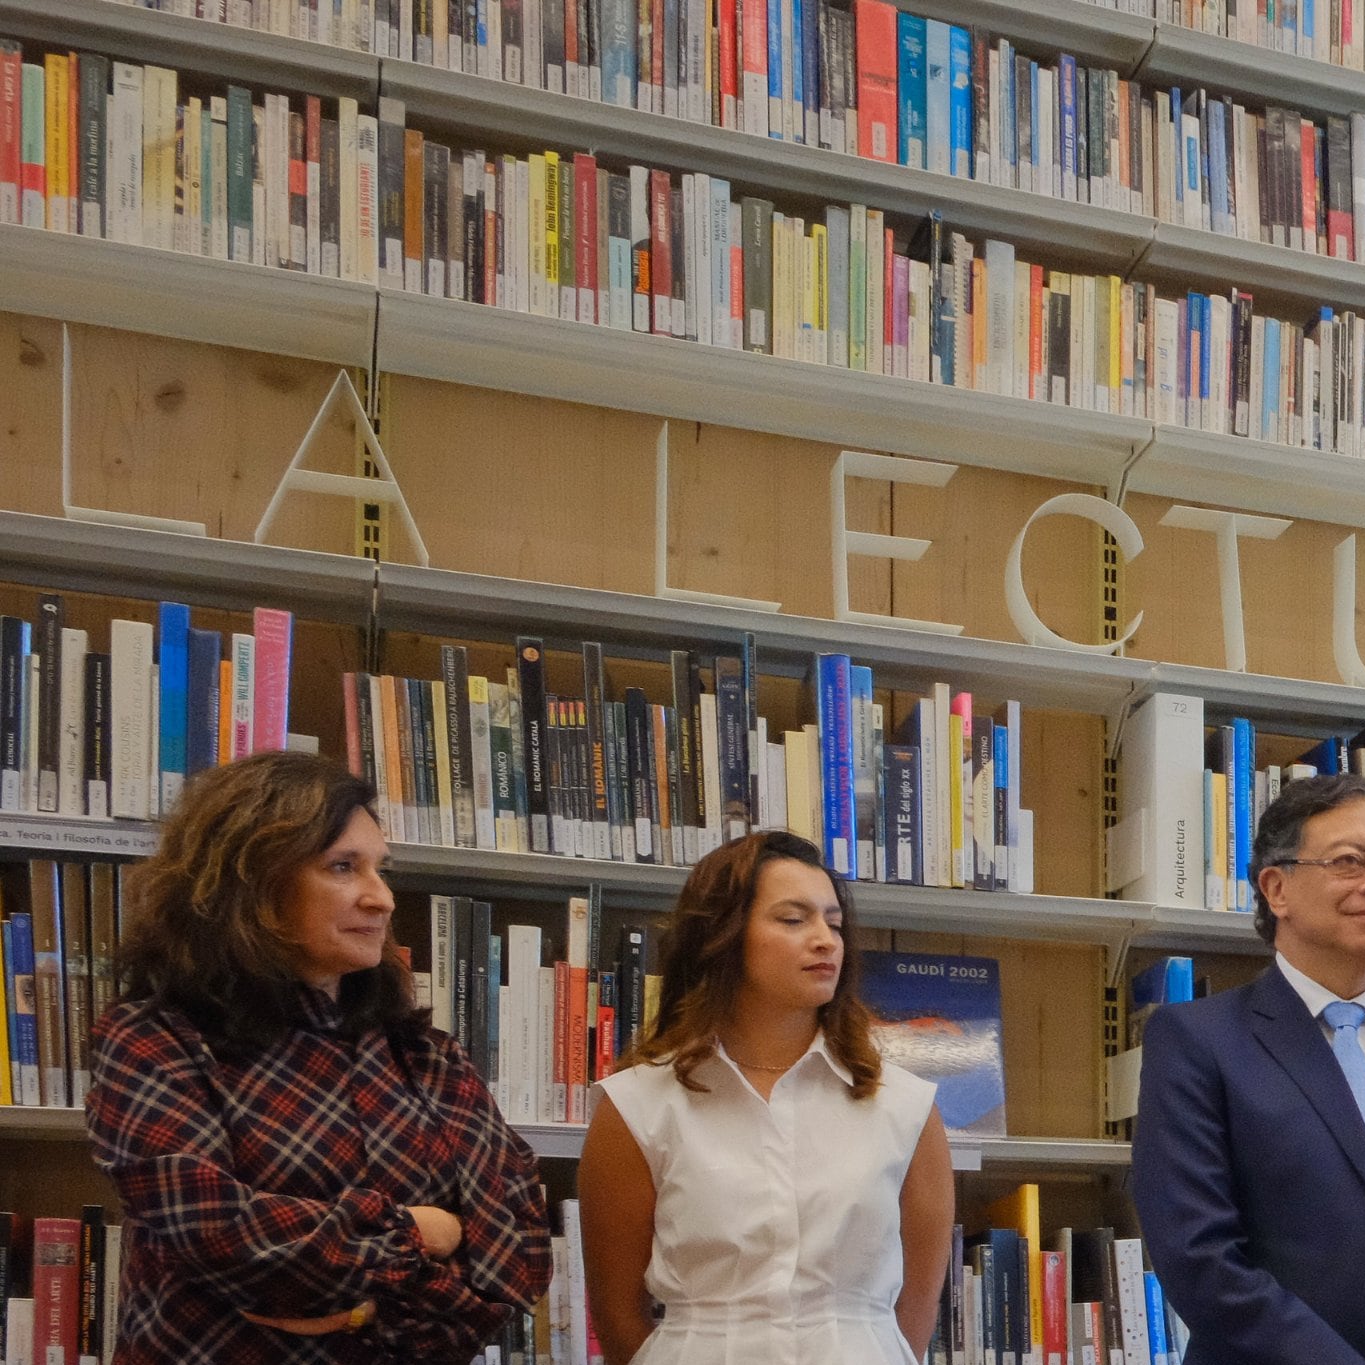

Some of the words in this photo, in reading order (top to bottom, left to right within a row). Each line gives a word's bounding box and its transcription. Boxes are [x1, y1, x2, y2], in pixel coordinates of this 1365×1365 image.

[62, 322, 432, 568] LA
[899, 780, 913, 799] siglo
[899, 799, 911, 812] del
[897, 813, 912, 846] RTE
[1174, 819, 1188, 900] Arquitectura
[896, 963, 945, 977] GAUDÍ
[949, 967, 989, 979] 2002
